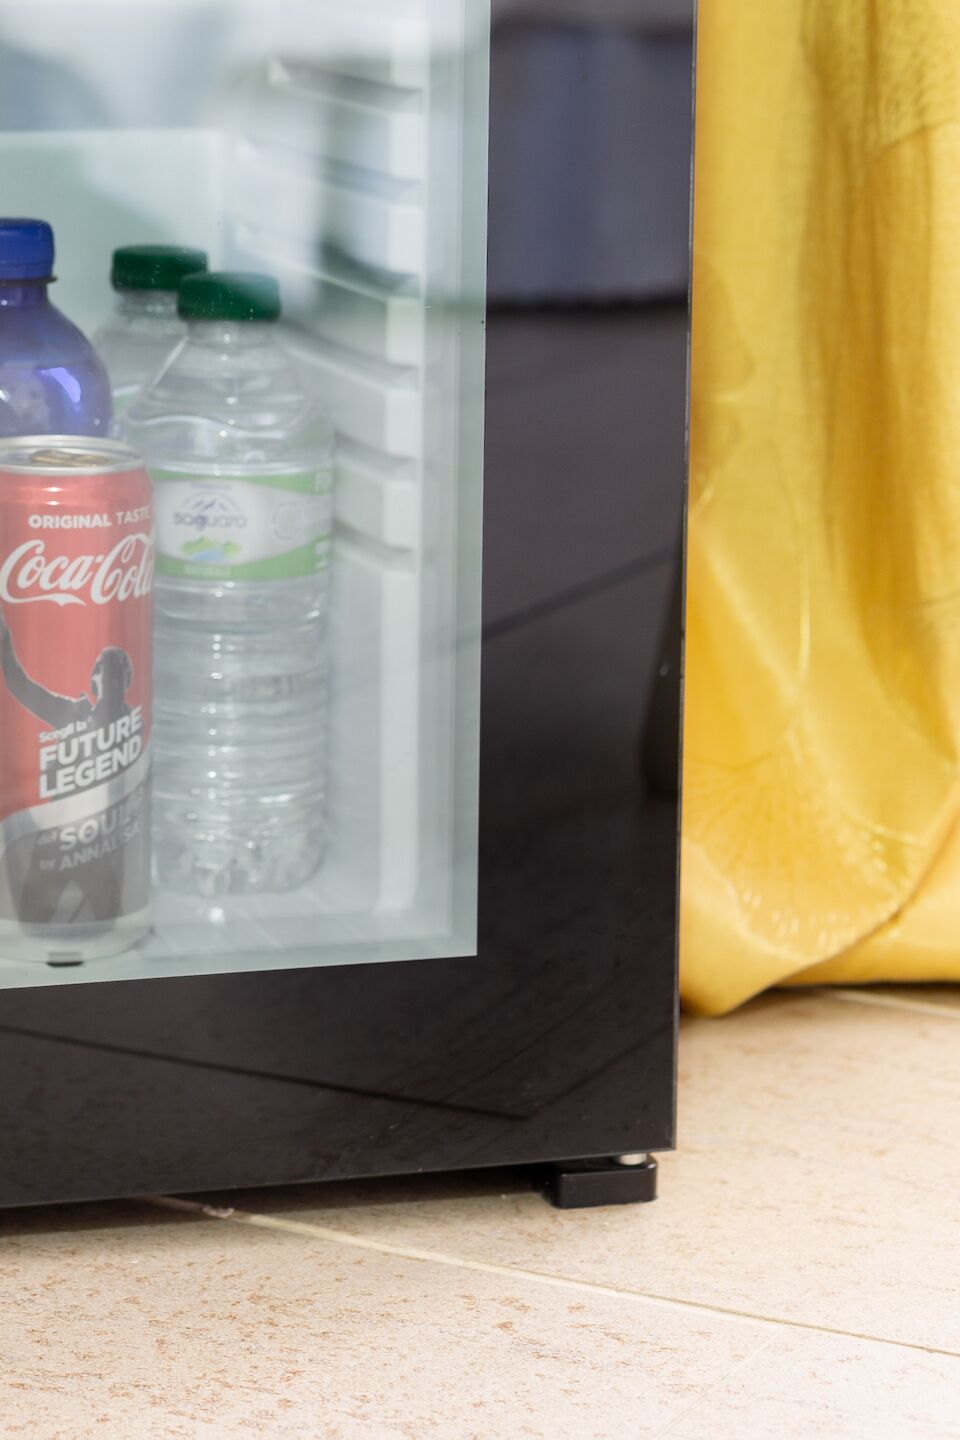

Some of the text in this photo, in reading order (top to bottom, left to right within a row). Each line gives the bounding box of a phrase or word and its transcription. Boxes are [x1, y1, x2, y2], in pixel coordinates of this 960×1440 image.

[28, 505, 150, 529] ORIGINAL TASTE
[39, 705, 142, 771] FUTURE
[39, 735, 142, 799] LEGEND
